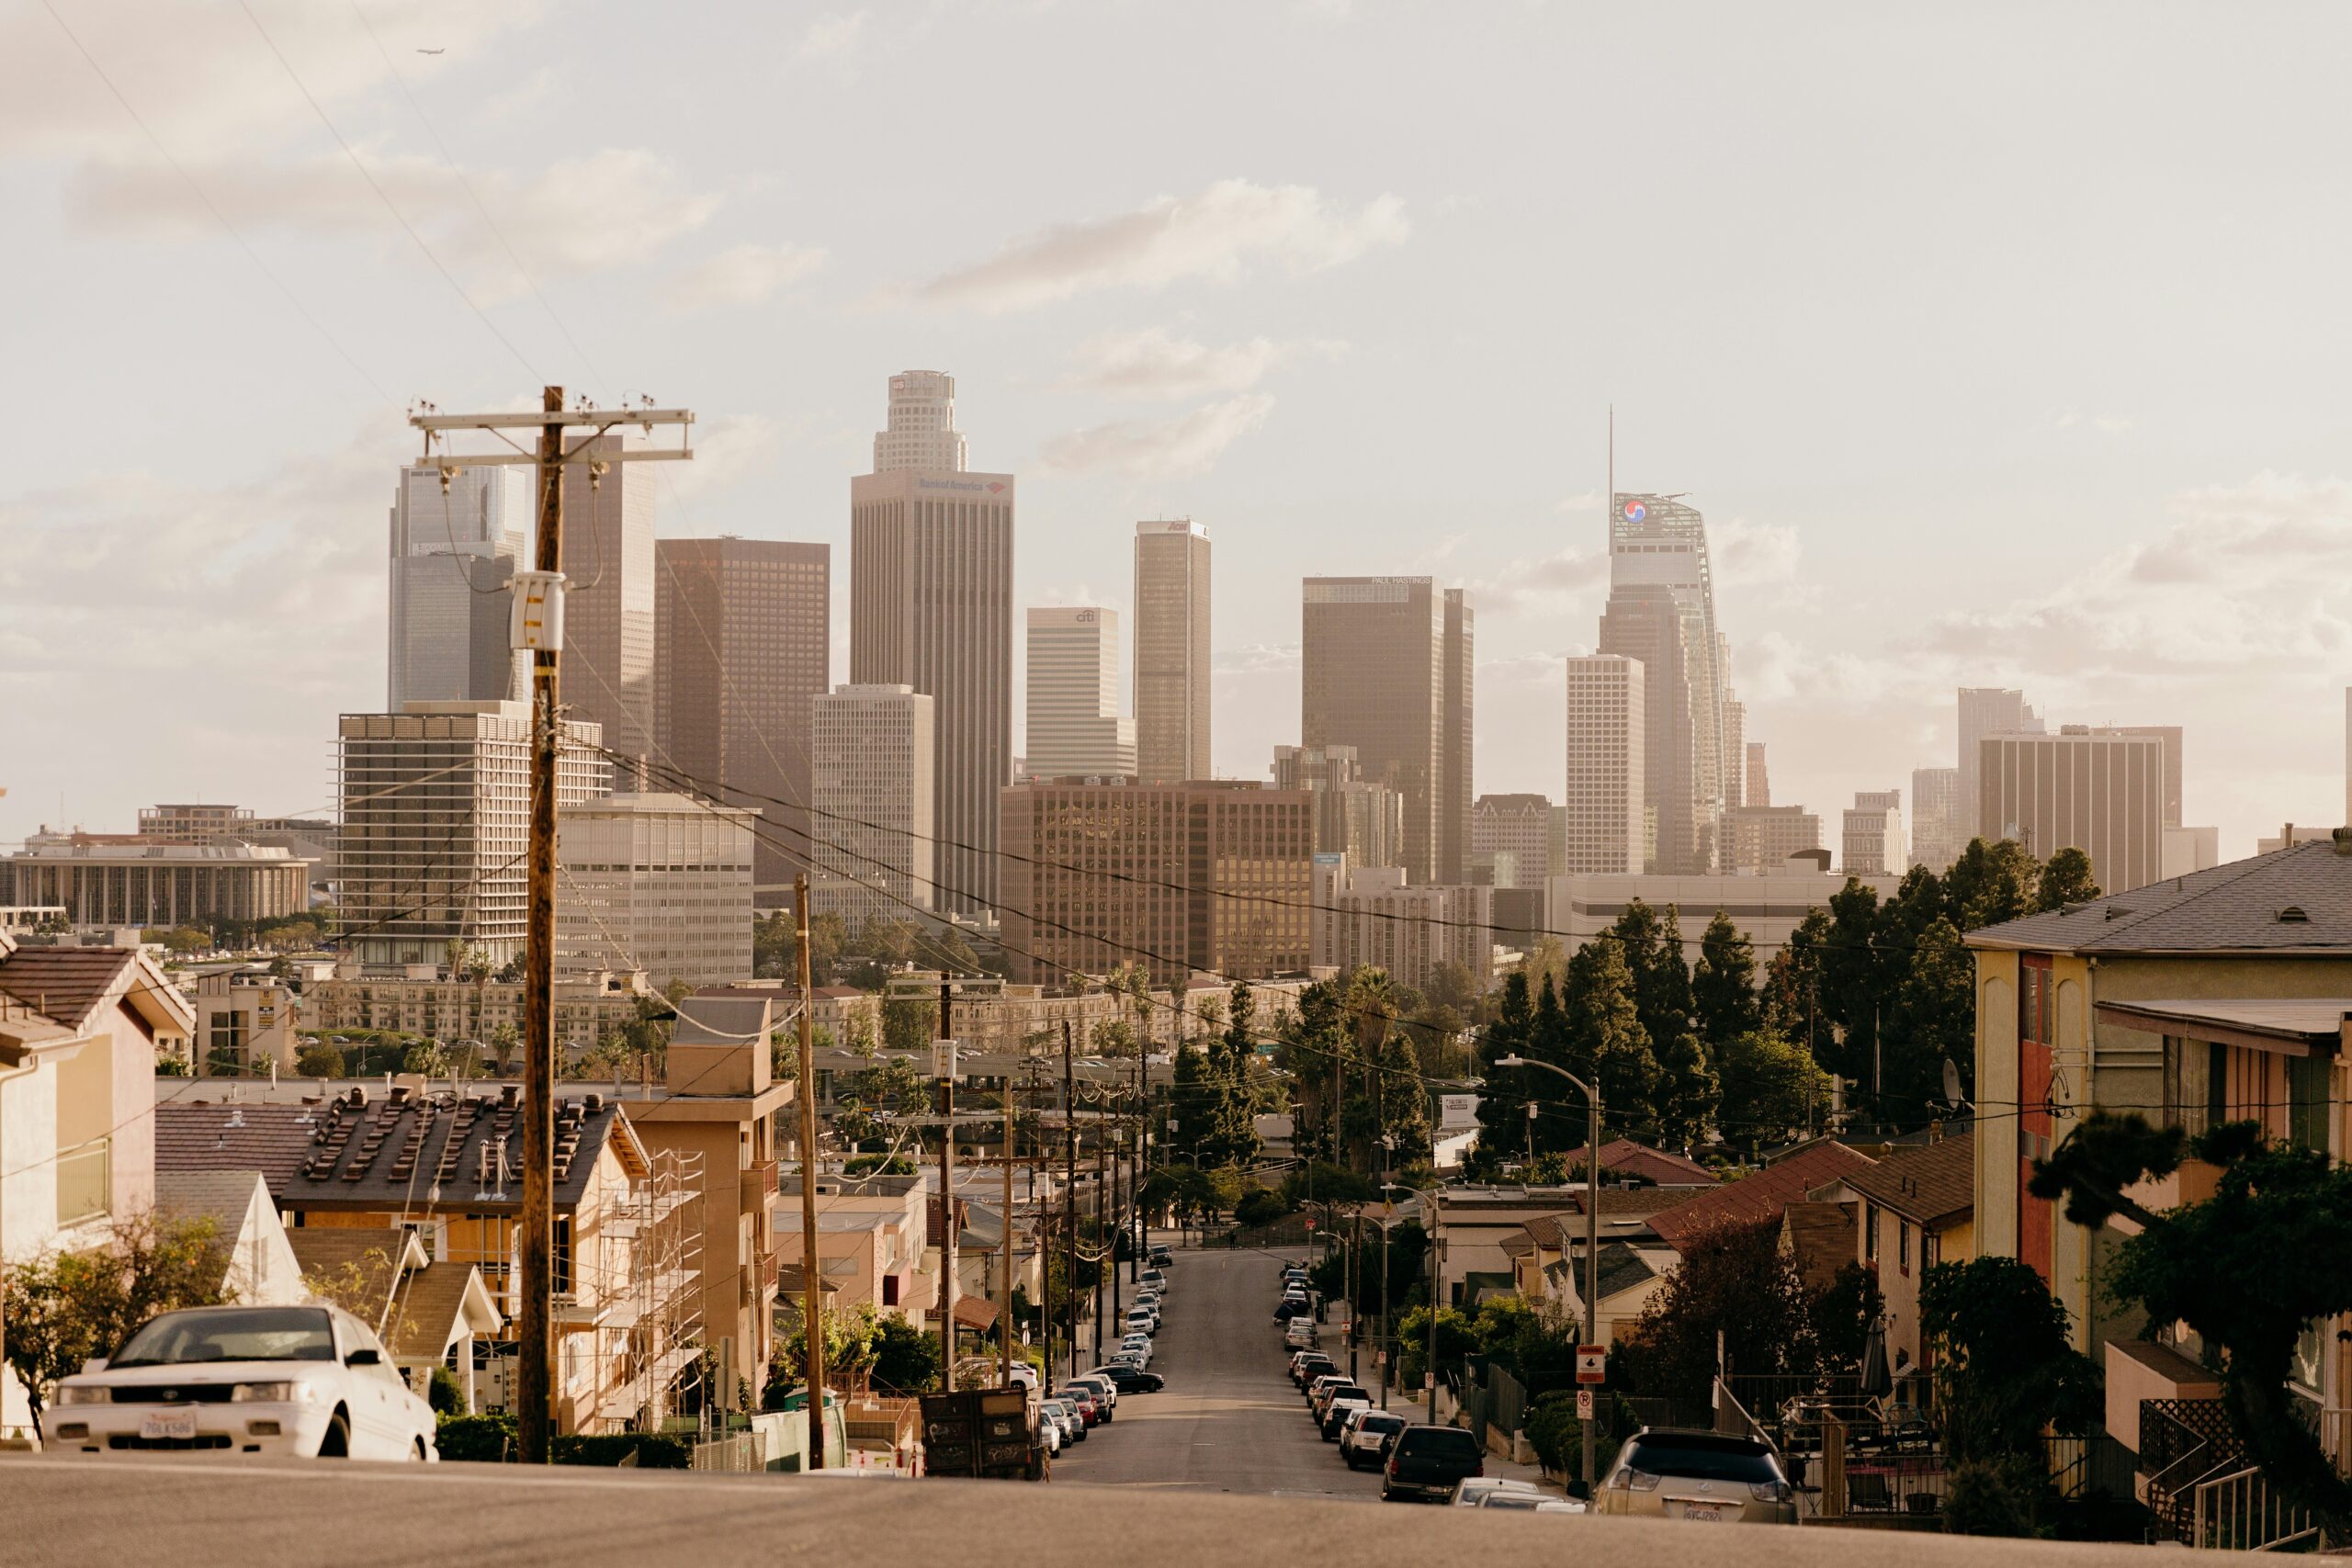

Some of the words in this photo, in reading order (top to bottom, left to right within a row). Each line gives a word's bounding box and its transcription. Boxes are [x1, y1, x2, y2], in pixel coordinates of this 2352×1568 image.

[920, 479, 939, 489] Bank
[940, 480, 949, 489] of
[950, 481, 984, 491] America
[1372, 576, 1391, 584] PAUL
[1392, 576, 1431, 584] HASTINGS
[1077, 610, 1094, 622] citi
